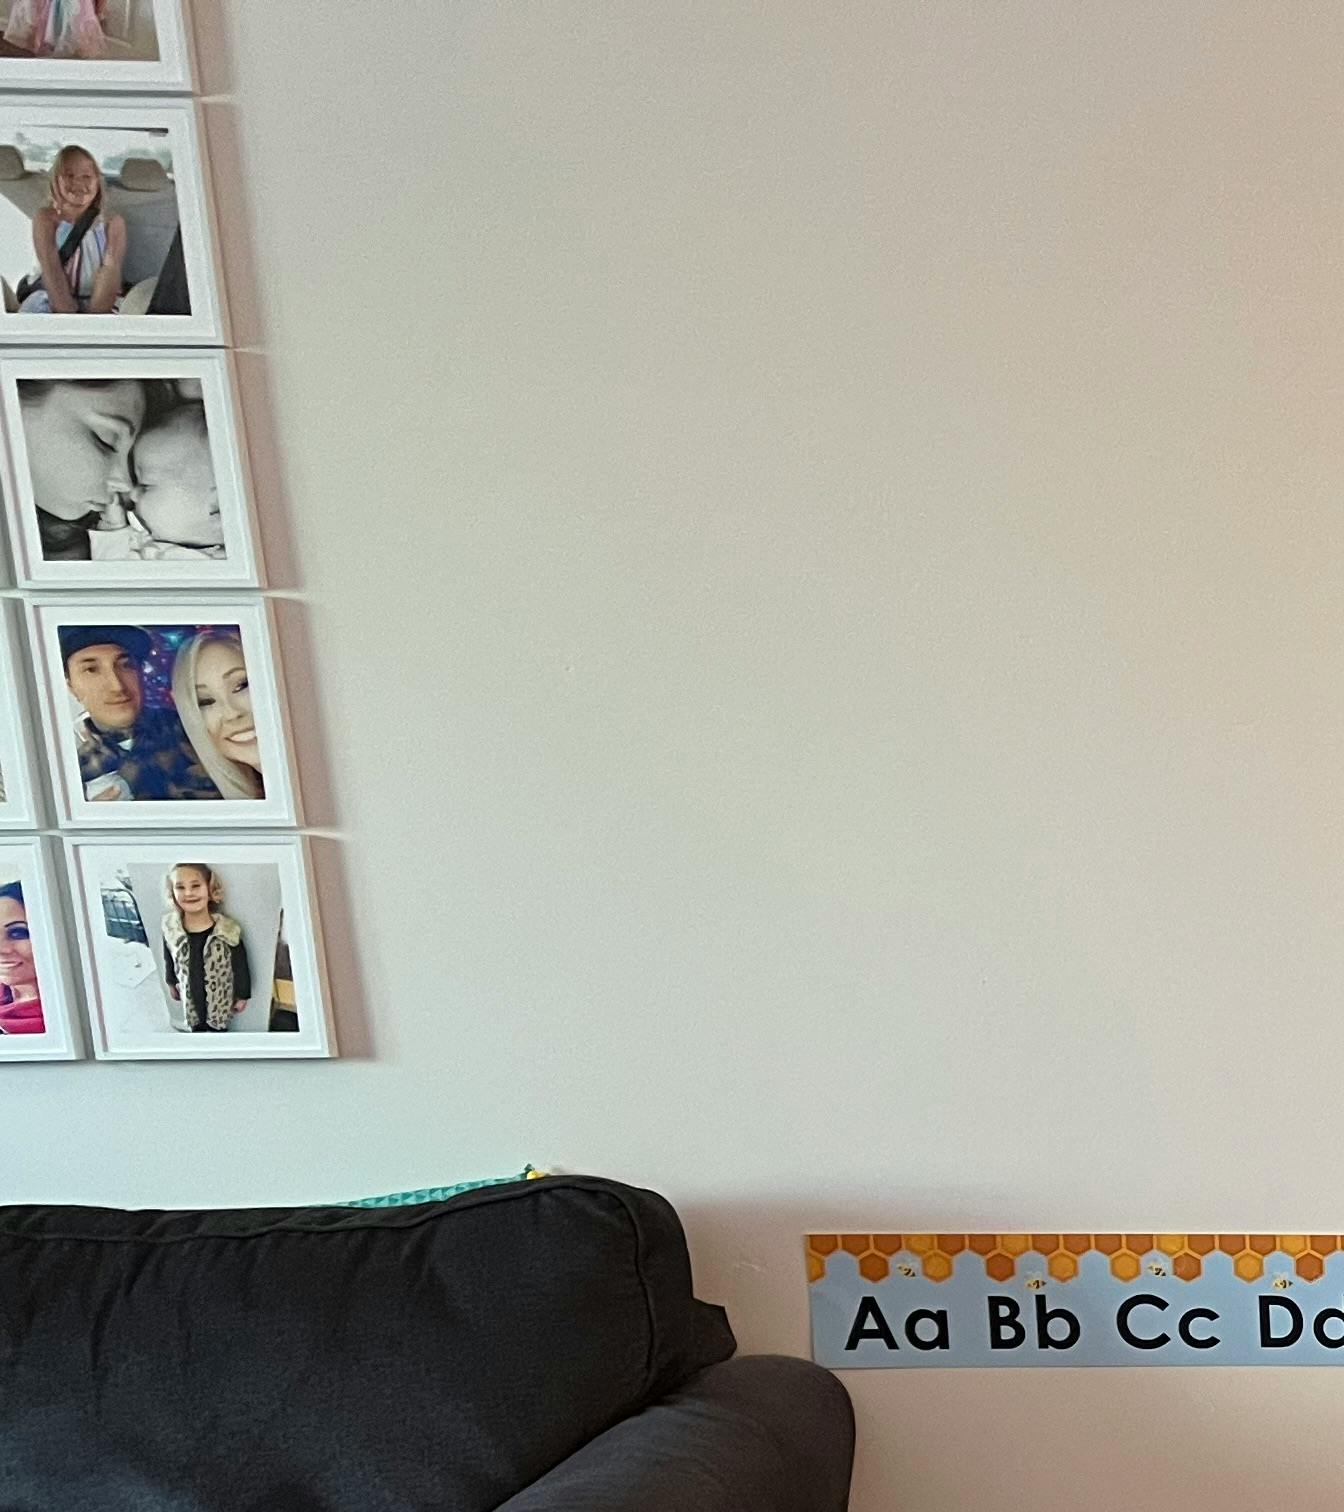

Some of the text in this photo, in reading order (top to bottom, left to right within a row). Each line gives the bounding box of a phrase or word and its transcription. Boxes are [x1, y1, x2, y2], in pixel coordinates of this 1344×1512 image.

[844, 1295, 950, 1351] Aa
[987, 1294, 1081, 1350] Bb
[1116, 1293, 1221, 1350] Cc
